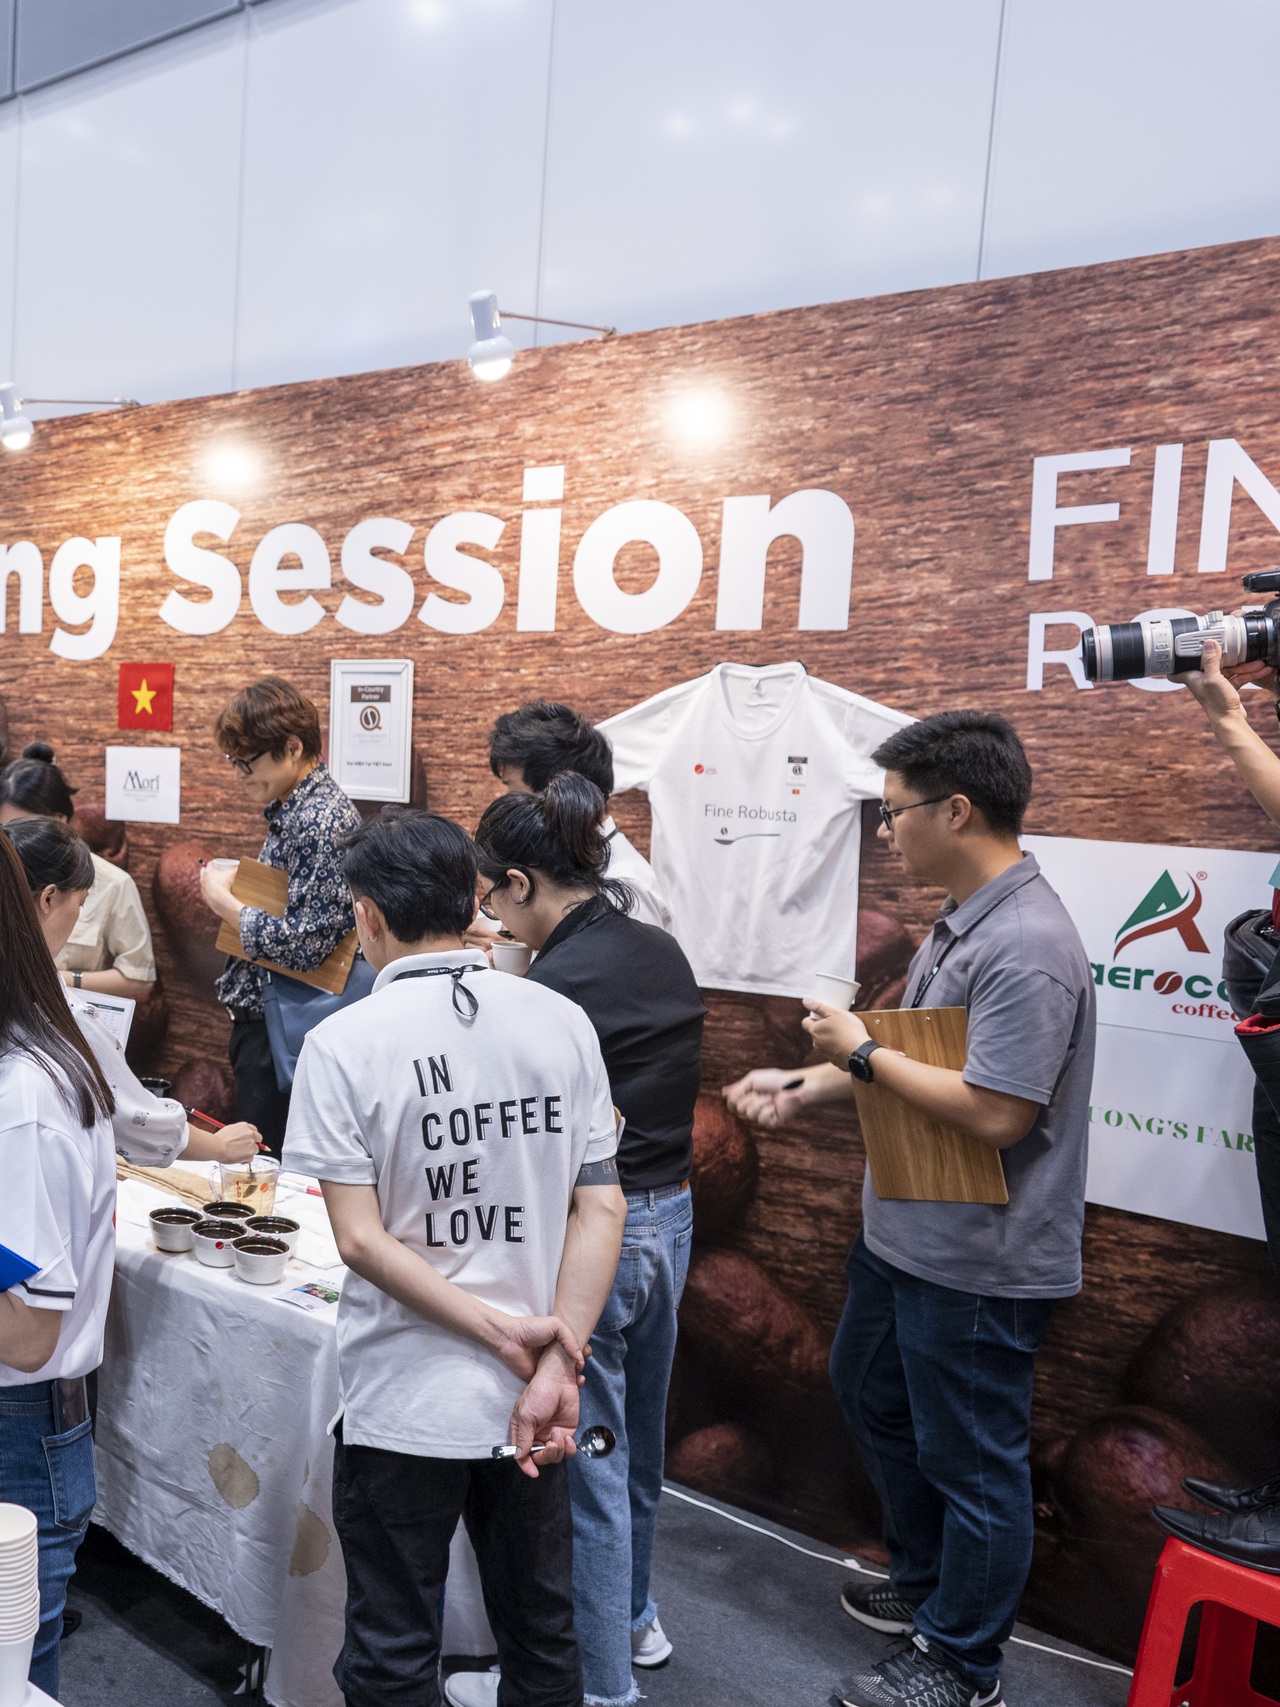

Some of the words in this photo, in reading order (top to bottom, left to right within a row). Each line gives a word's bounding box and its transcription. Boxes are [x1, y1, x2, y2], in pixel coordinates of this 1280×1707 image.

[159, 465, 855, 635] Session
[704, 804, 734, 818] Fine
[738, 807, 797, 822] Robusta
[413, 1054, 454, 1097] IN
[421, 1095, 565, 1150] COFFEE
[425, 1158, 481, 1200] WE
[425, 1205, 526, 1247] LOVE
